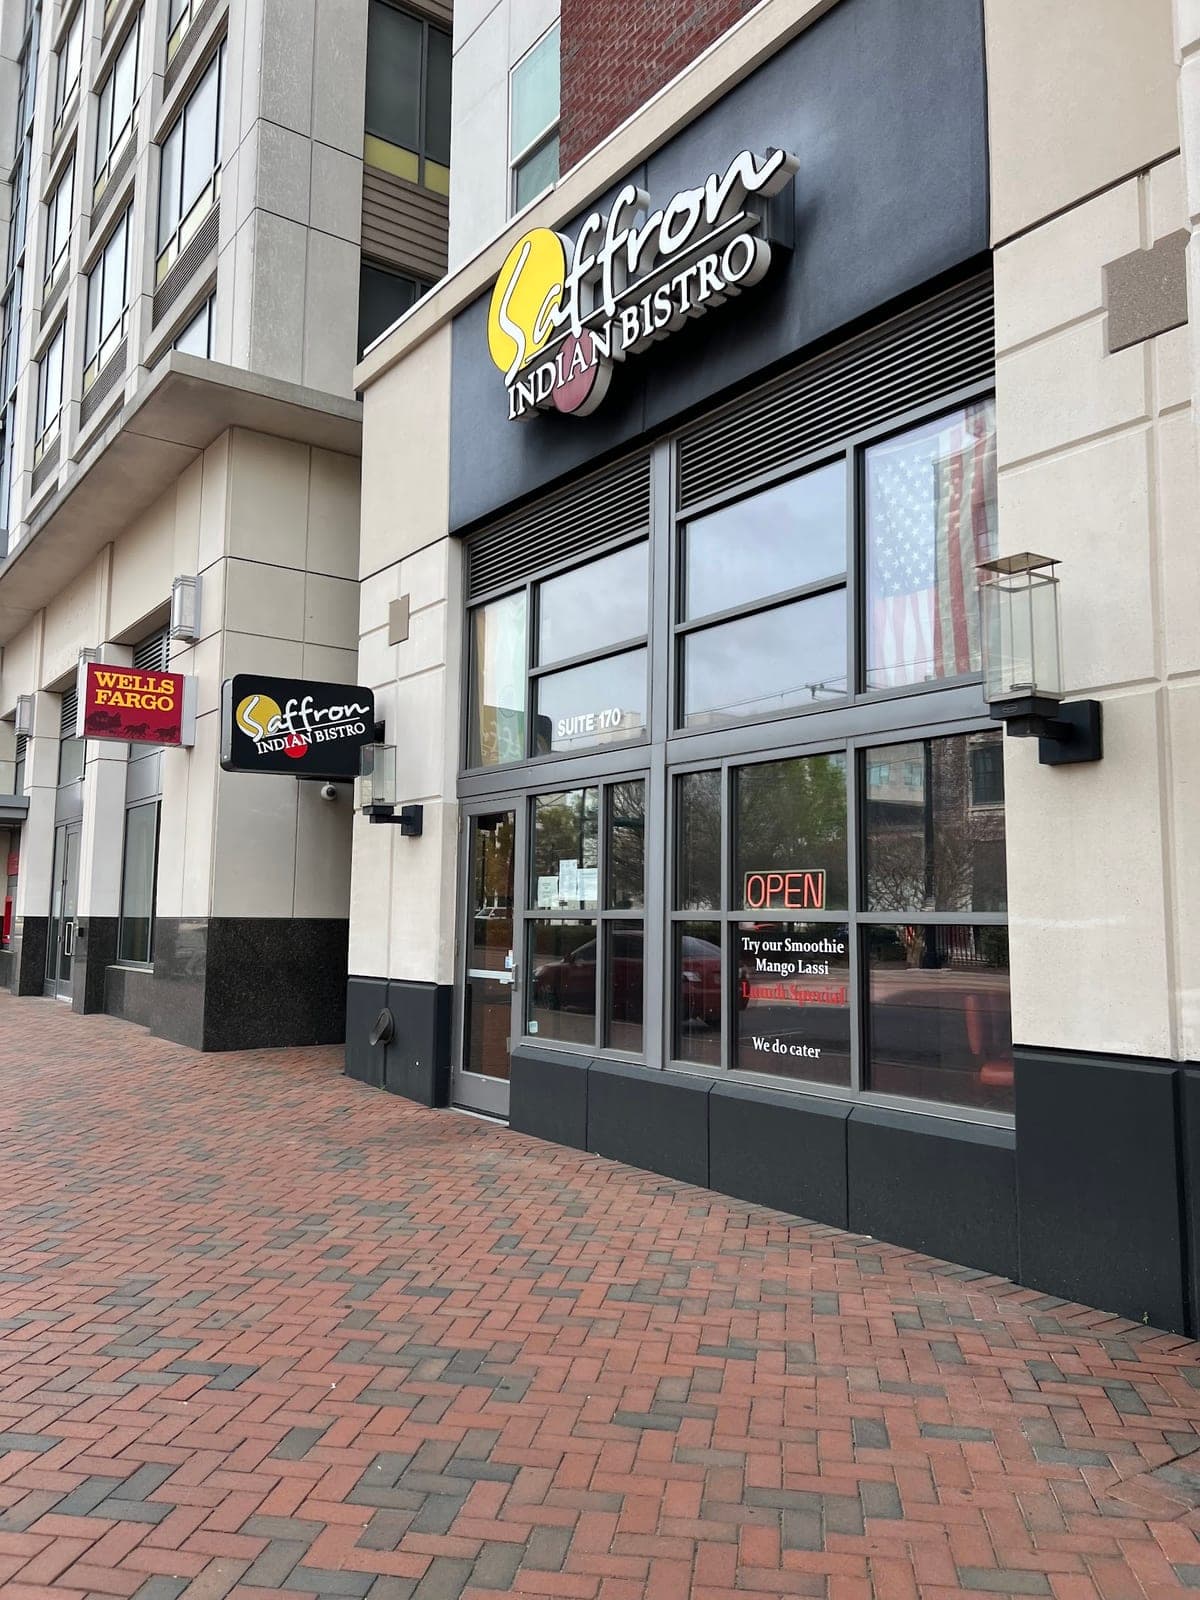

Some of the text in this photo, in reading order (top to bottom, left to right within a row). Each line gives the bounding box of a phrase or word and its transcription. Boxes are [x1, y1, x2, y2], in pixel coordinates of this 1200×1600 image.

[499, 150, 786, 386] Saffron
[507, 233, 757, 420] INDIAN BISTRO
[94, 670, 175, 695] WELLS
[95, 689, 174, 712] FARGO
[243, 695, 370, 742] Saffron
[557, 708, 620, 737] SUITE 170
[256, 722, 366, 754] INDIAN BISTRO
[747, 873, 823, 909] OPEN
[742, 937, 845, 955] Try our Smoothie
[755, 957, 829, 976] Mango Lassi
[752, 1036, 821, 1059] We do cater
